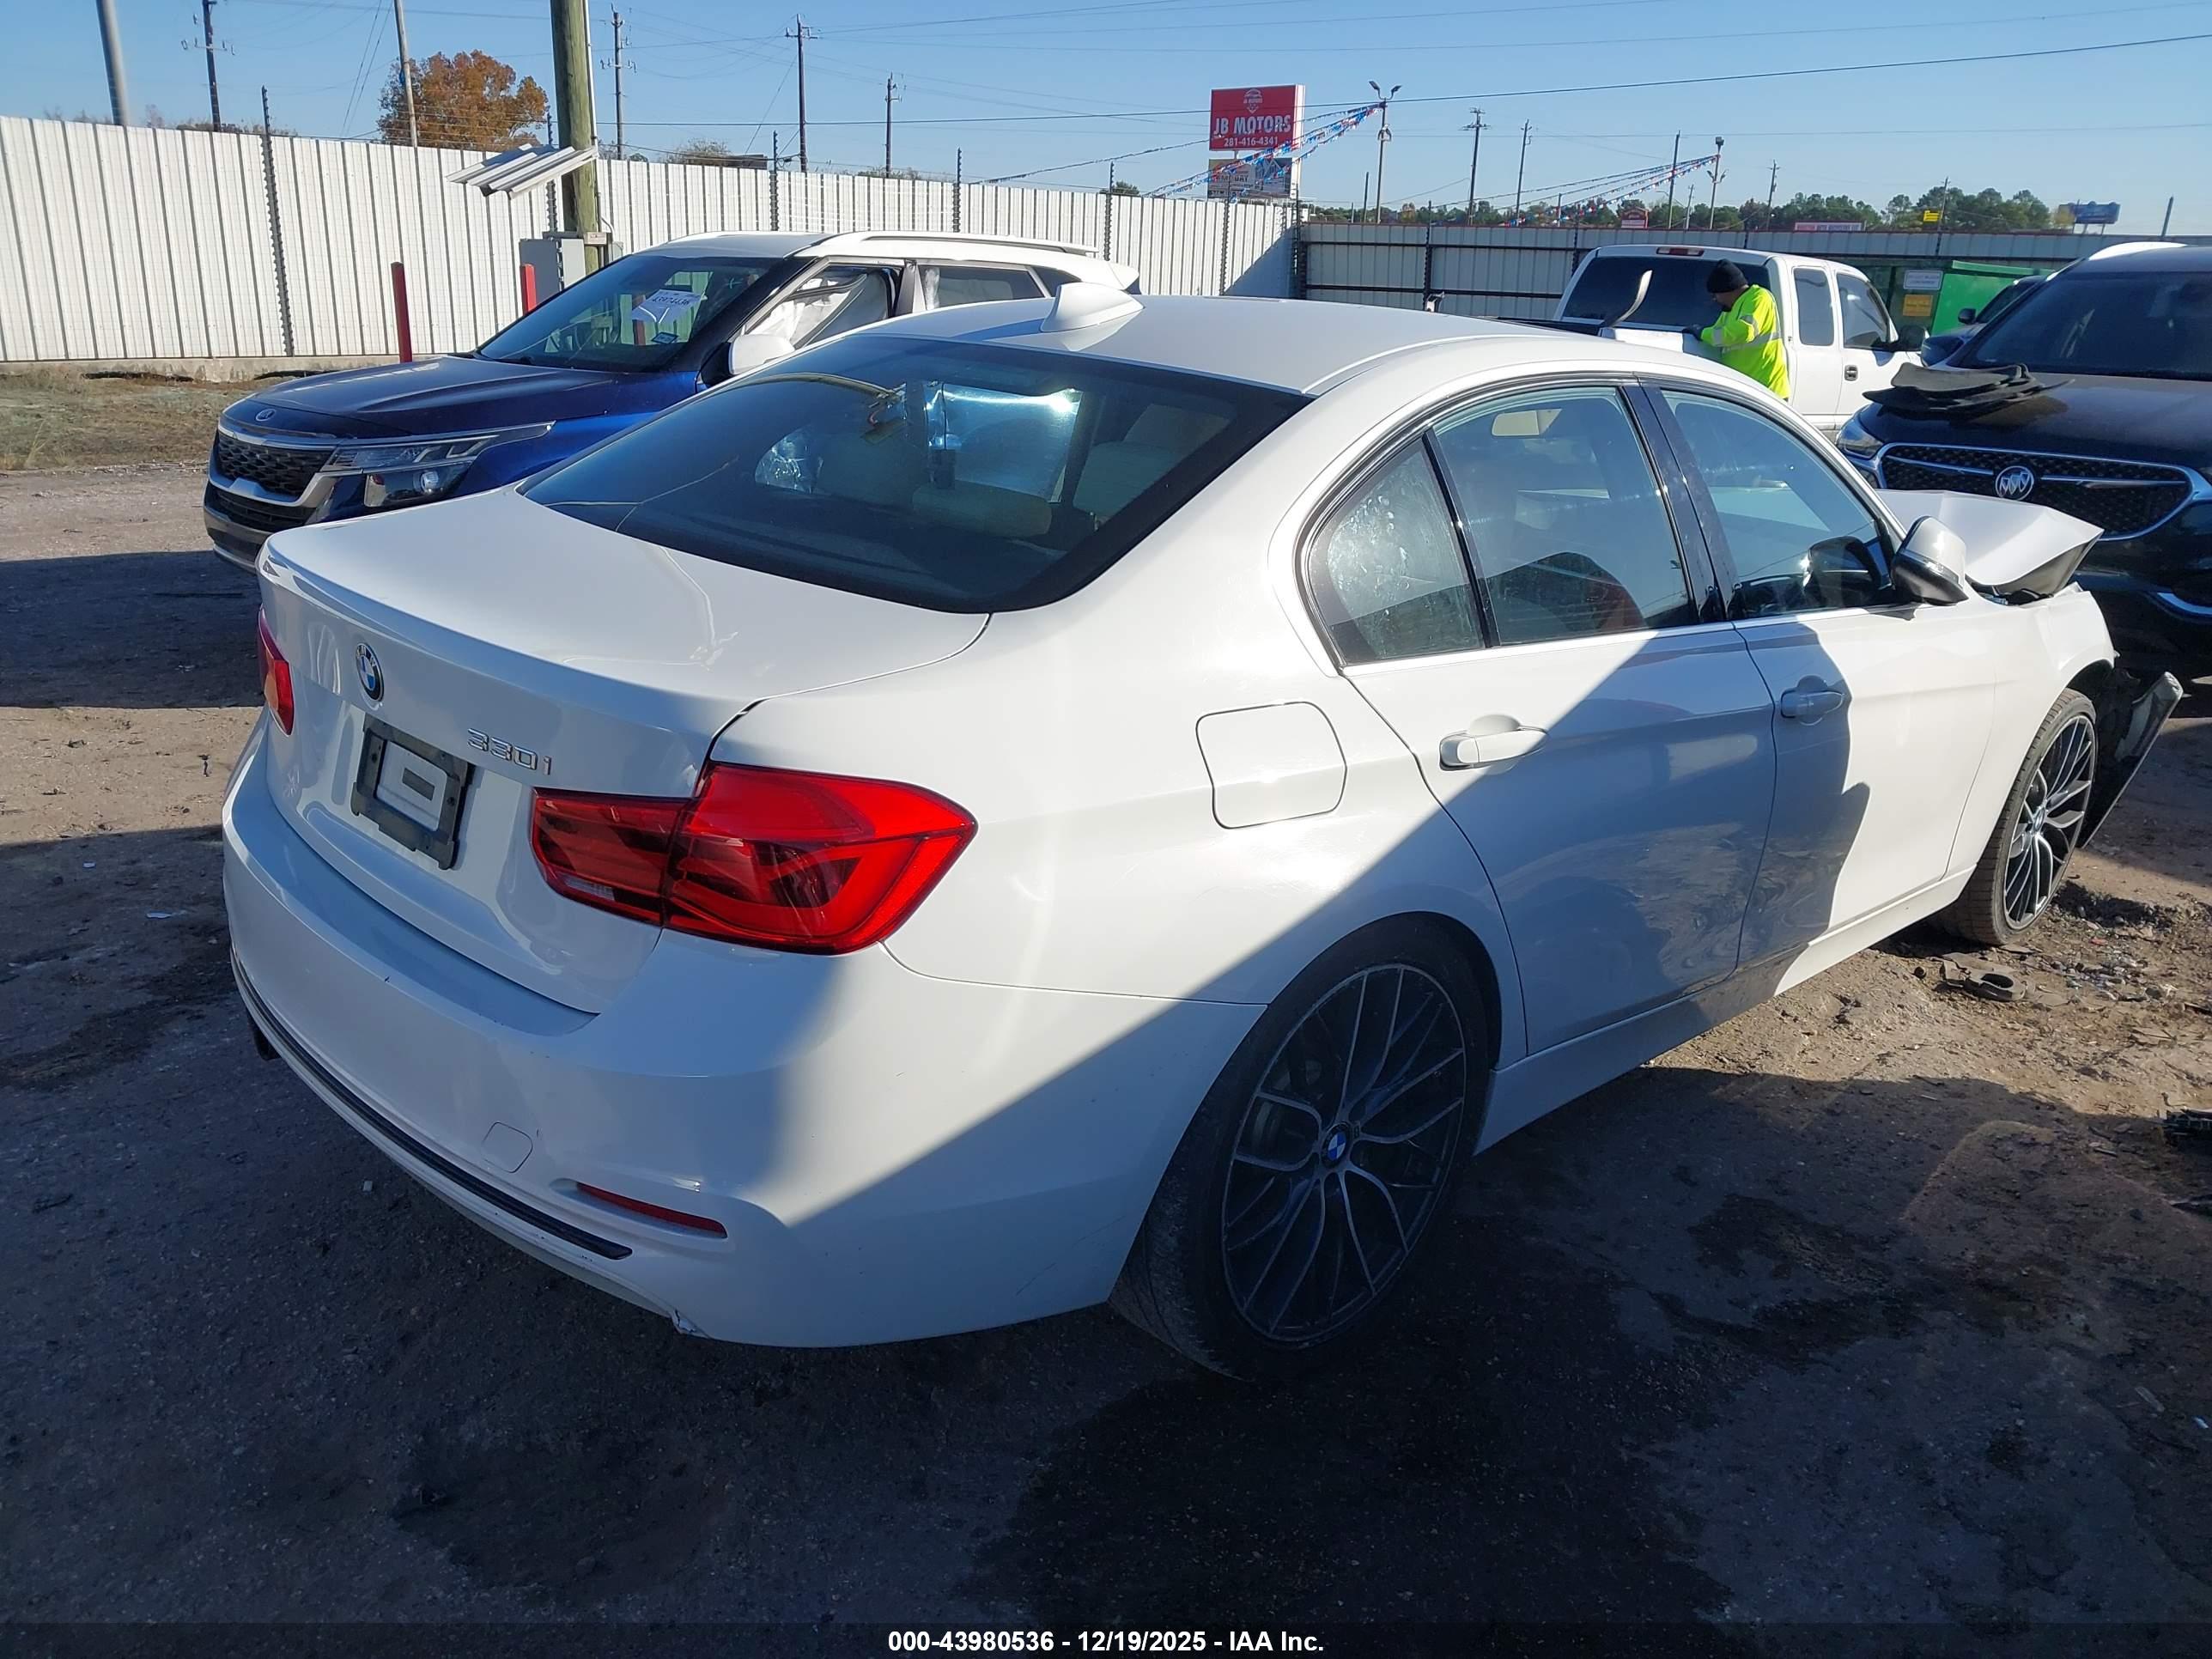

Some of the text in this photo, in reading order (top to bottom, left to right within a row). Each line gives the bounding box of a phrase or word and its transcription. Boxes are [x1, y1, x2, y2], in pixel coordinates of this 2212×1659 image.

[1213, 114, 1291, 135] JB MOTORS
[1224, 136, 1279, 148] 281-416-4341
